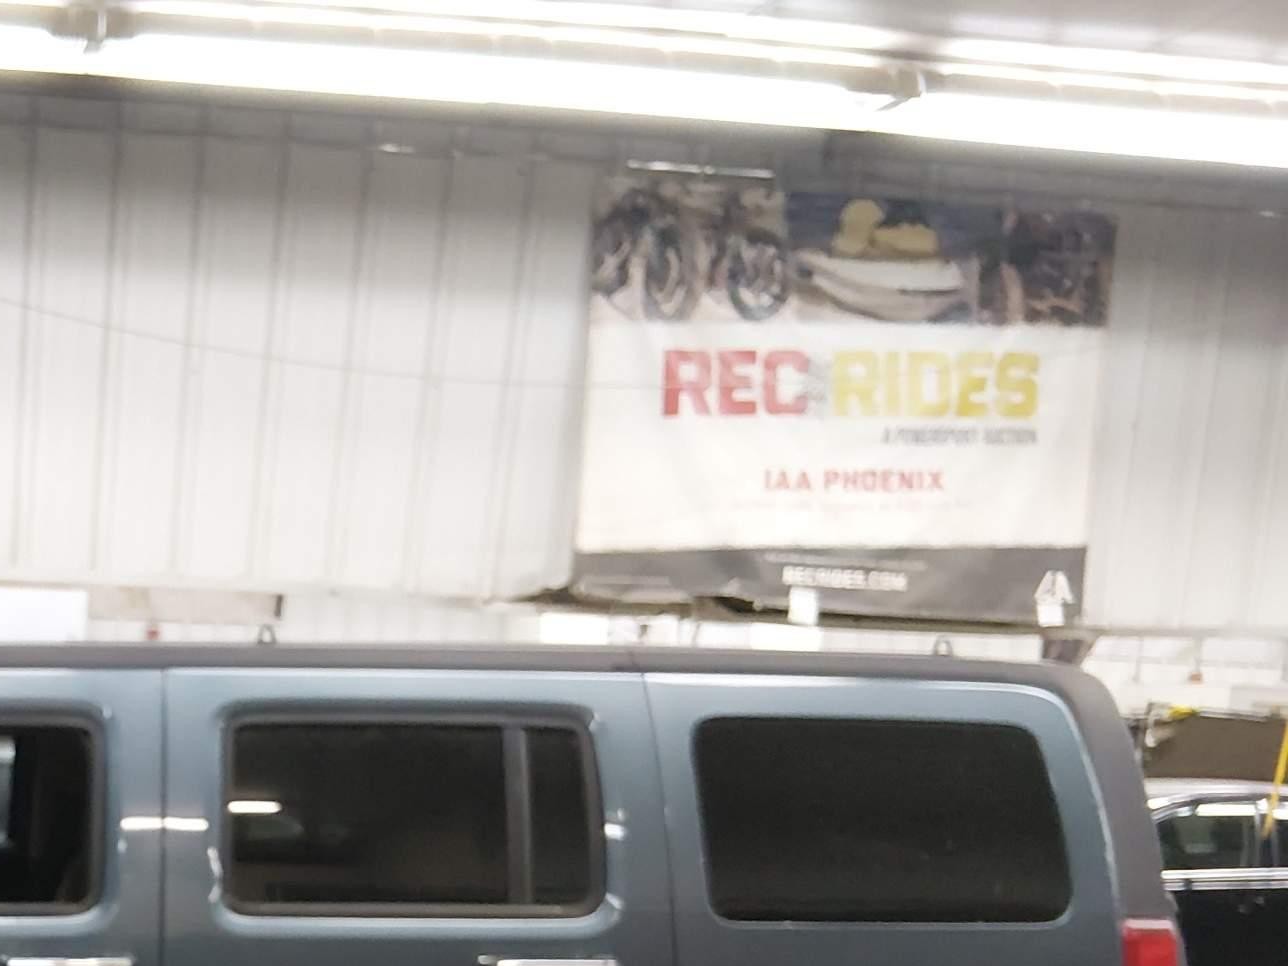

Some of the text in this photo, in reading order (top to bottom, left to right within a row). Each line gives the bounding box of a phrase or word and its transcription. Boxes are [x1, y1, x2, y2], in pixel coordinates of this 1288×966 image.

[661, 349, 811, 418] REC
[831, 349, 1041, 419] RIDES
[764, 468, 944, 493] IAA PHOENIX
